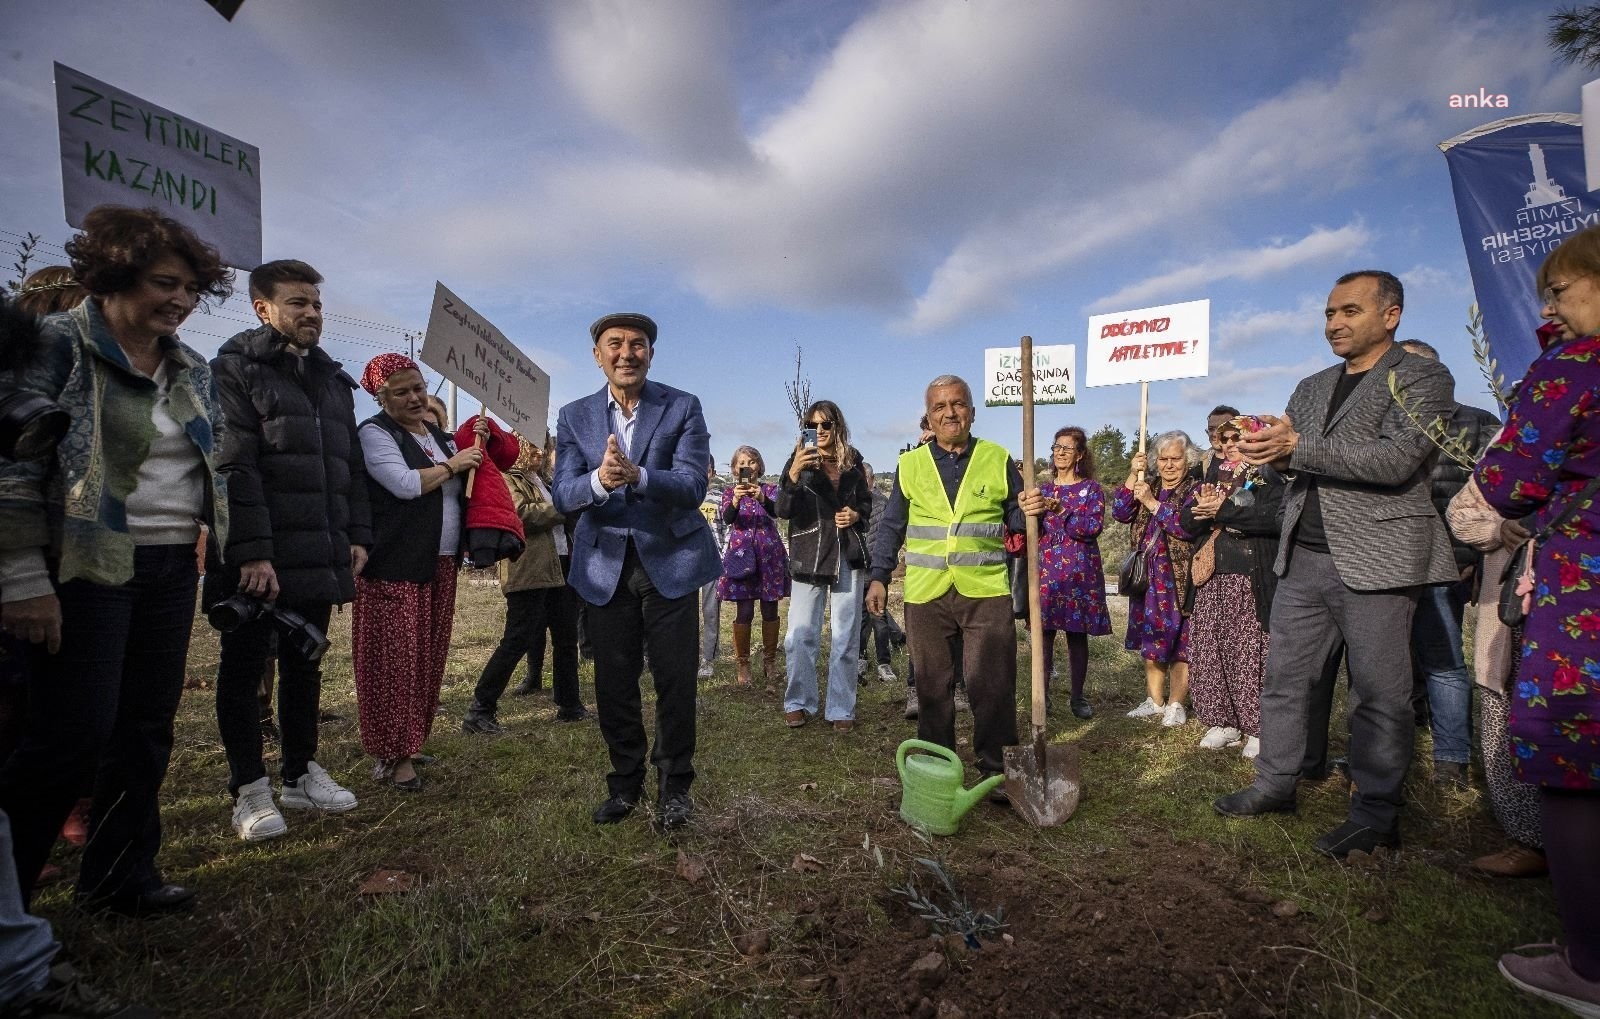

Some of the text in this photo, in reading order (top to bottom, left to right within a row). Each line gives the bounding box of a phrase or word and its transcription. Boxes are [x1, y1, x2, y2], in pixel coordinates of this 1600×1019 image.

[69, 85, 253, 177] ZEYTİNLER
[84, 140, 216, 215] KAZANDI
[445, 345, 488, 392] Almak
[475, 343, 512, 384] Nefes
[996, 367, 1070, 382] DAĞARINDA
[991, 383, 1068, 400] ÇİÇEKR AÇAR
